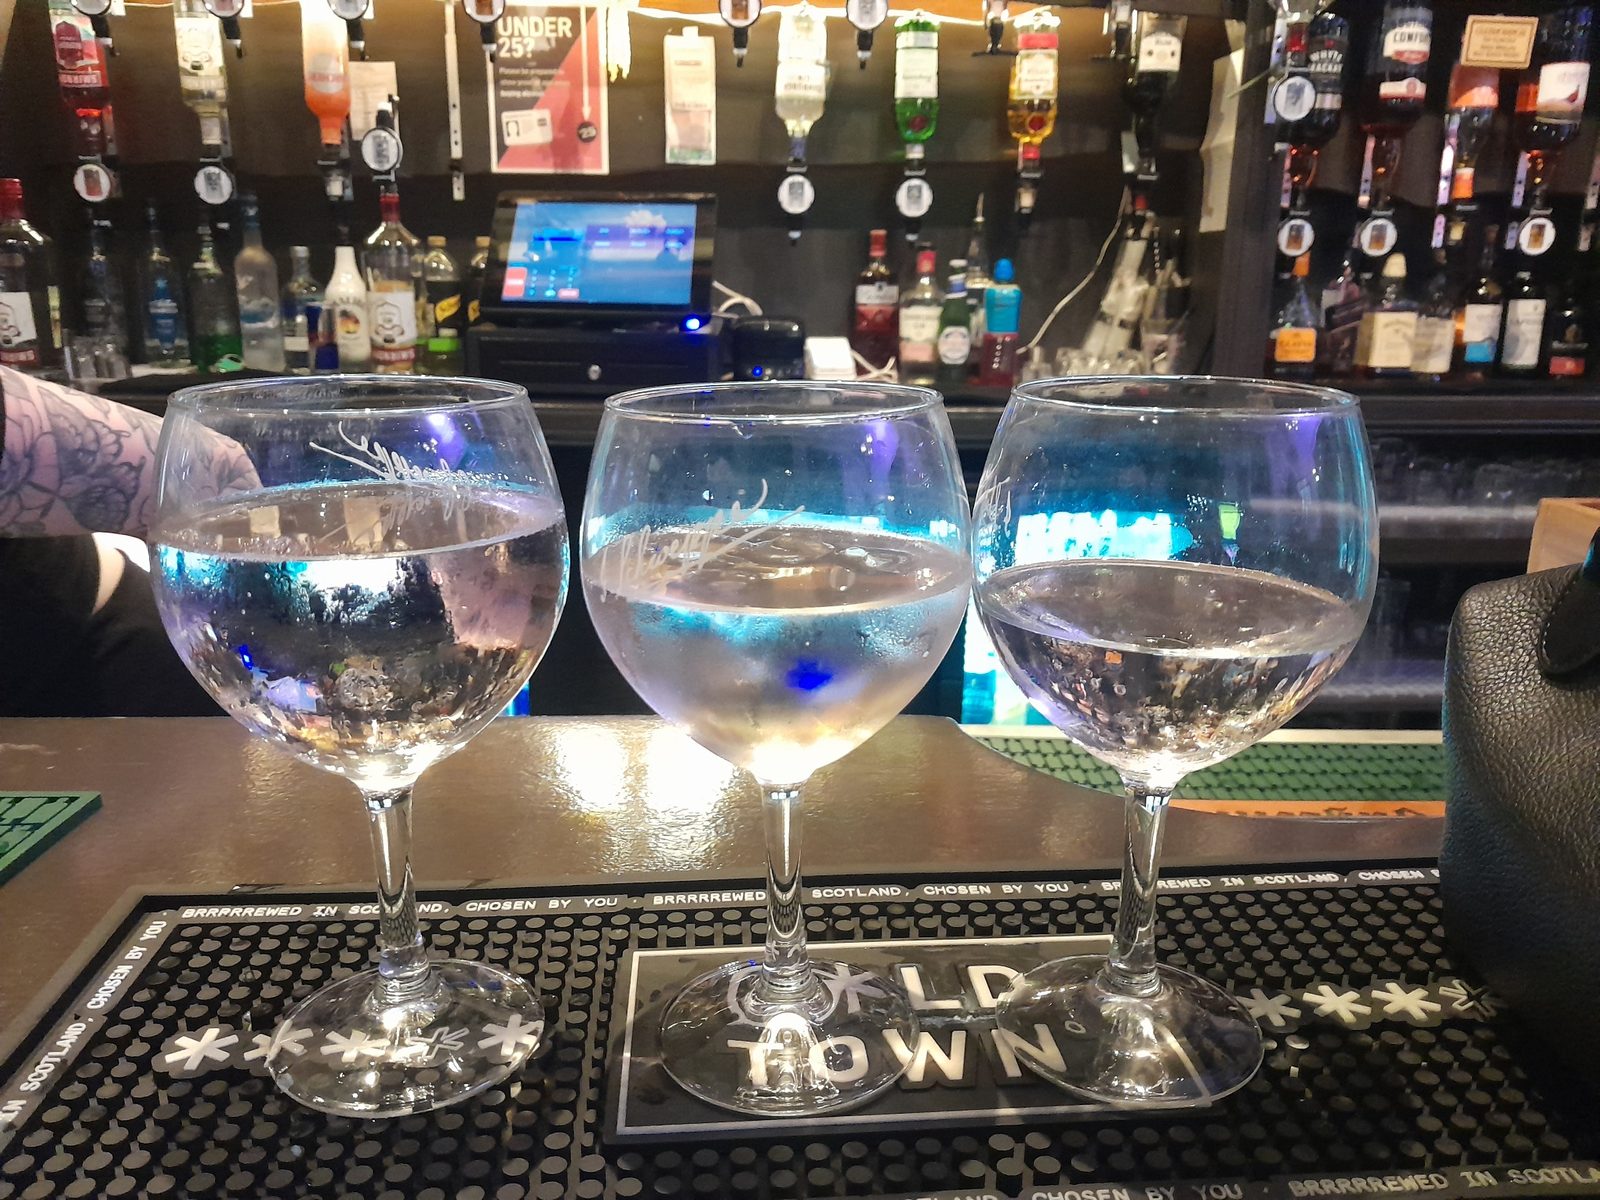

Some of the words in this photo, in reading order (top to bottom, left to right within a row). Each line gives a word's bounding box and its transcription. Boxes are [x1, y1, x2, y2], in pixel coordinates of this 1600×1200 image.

[497, 15, 572, 38] UNDER
[497, 37, 535, 58] 25?
[181, 906, 303, 919] BRRRRREWED
[311, 905, 339, 918] IN
[465, 900, 537, 912] CHOSEN
[548, 898, 572, 910] BY
[583, 897, 618, 909] YOU
[653, 891, 767, 905] BRRRRREWED
[811, 886, 909, 899] SCOTLAND,
[923, 884, 992, 896] CHOSEN
[1001, 883, 1024, 894] BY
[1034, 881, 1070, 893] YOU
[1223, 876, 1246, 887] IN
[1357, 869, 1425, 881] CHOSEN
[86, 964, 134, 1010] CHOSEN
[124, 945, 147, 961] BY
[139, 920, 168, 942] YOU
[726, 1022, 1068, 1088] TOWN
[1192, 1183, 1244, 1200] YOU
[1459, 1170, 1499, 1188] IN
